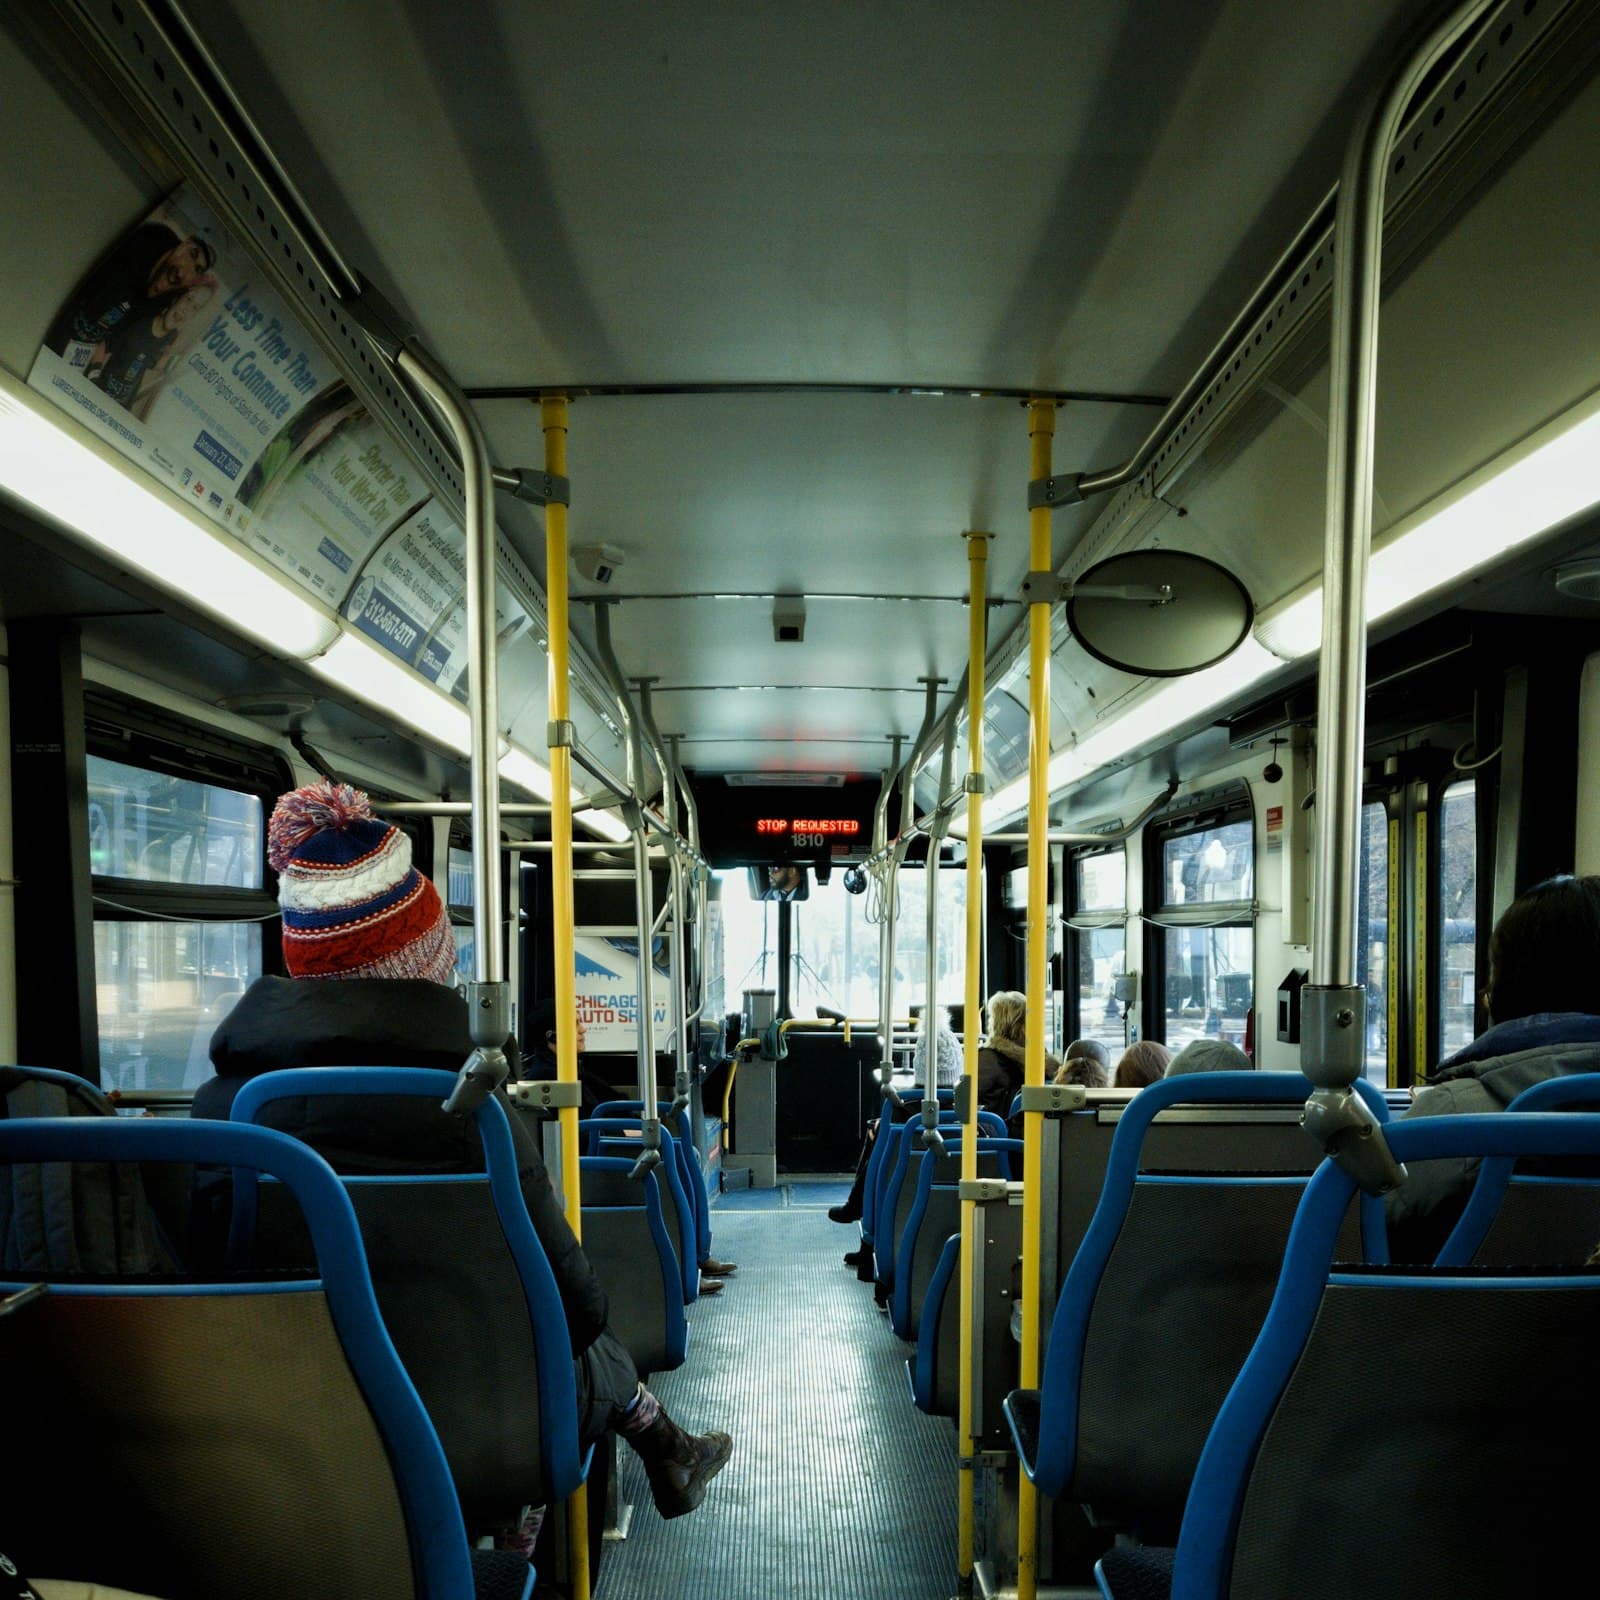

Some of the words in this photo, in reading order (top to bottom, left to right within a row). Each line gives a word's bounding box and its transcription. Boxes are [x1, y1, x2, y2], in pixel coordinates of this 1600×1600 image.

[224, 282, 264, 331] Less
[254, 318, 291, 365] Time
[283, 351, 317, 395] Than
[188, 353, 208, 376] Climb
[203, 368, 219, 384] 80
[212, 376, 234, 400] Flights
[202, 314, 240, 362] Your
[232, 350, 290, 419] Commute
[197, 436, 219, 461] January
[358, 444, 396, 485] Shorter
[387, 475, 411, 506] Than
[331, 453, 356, 486] Your
[349, 475, 377, 510] Work
[368, 498, 391, 528] Day
[757, 820, 788, 832] STOP
[793, 820, 859, 832] REQUESTED
[791, 833, 824, 847] 1810
